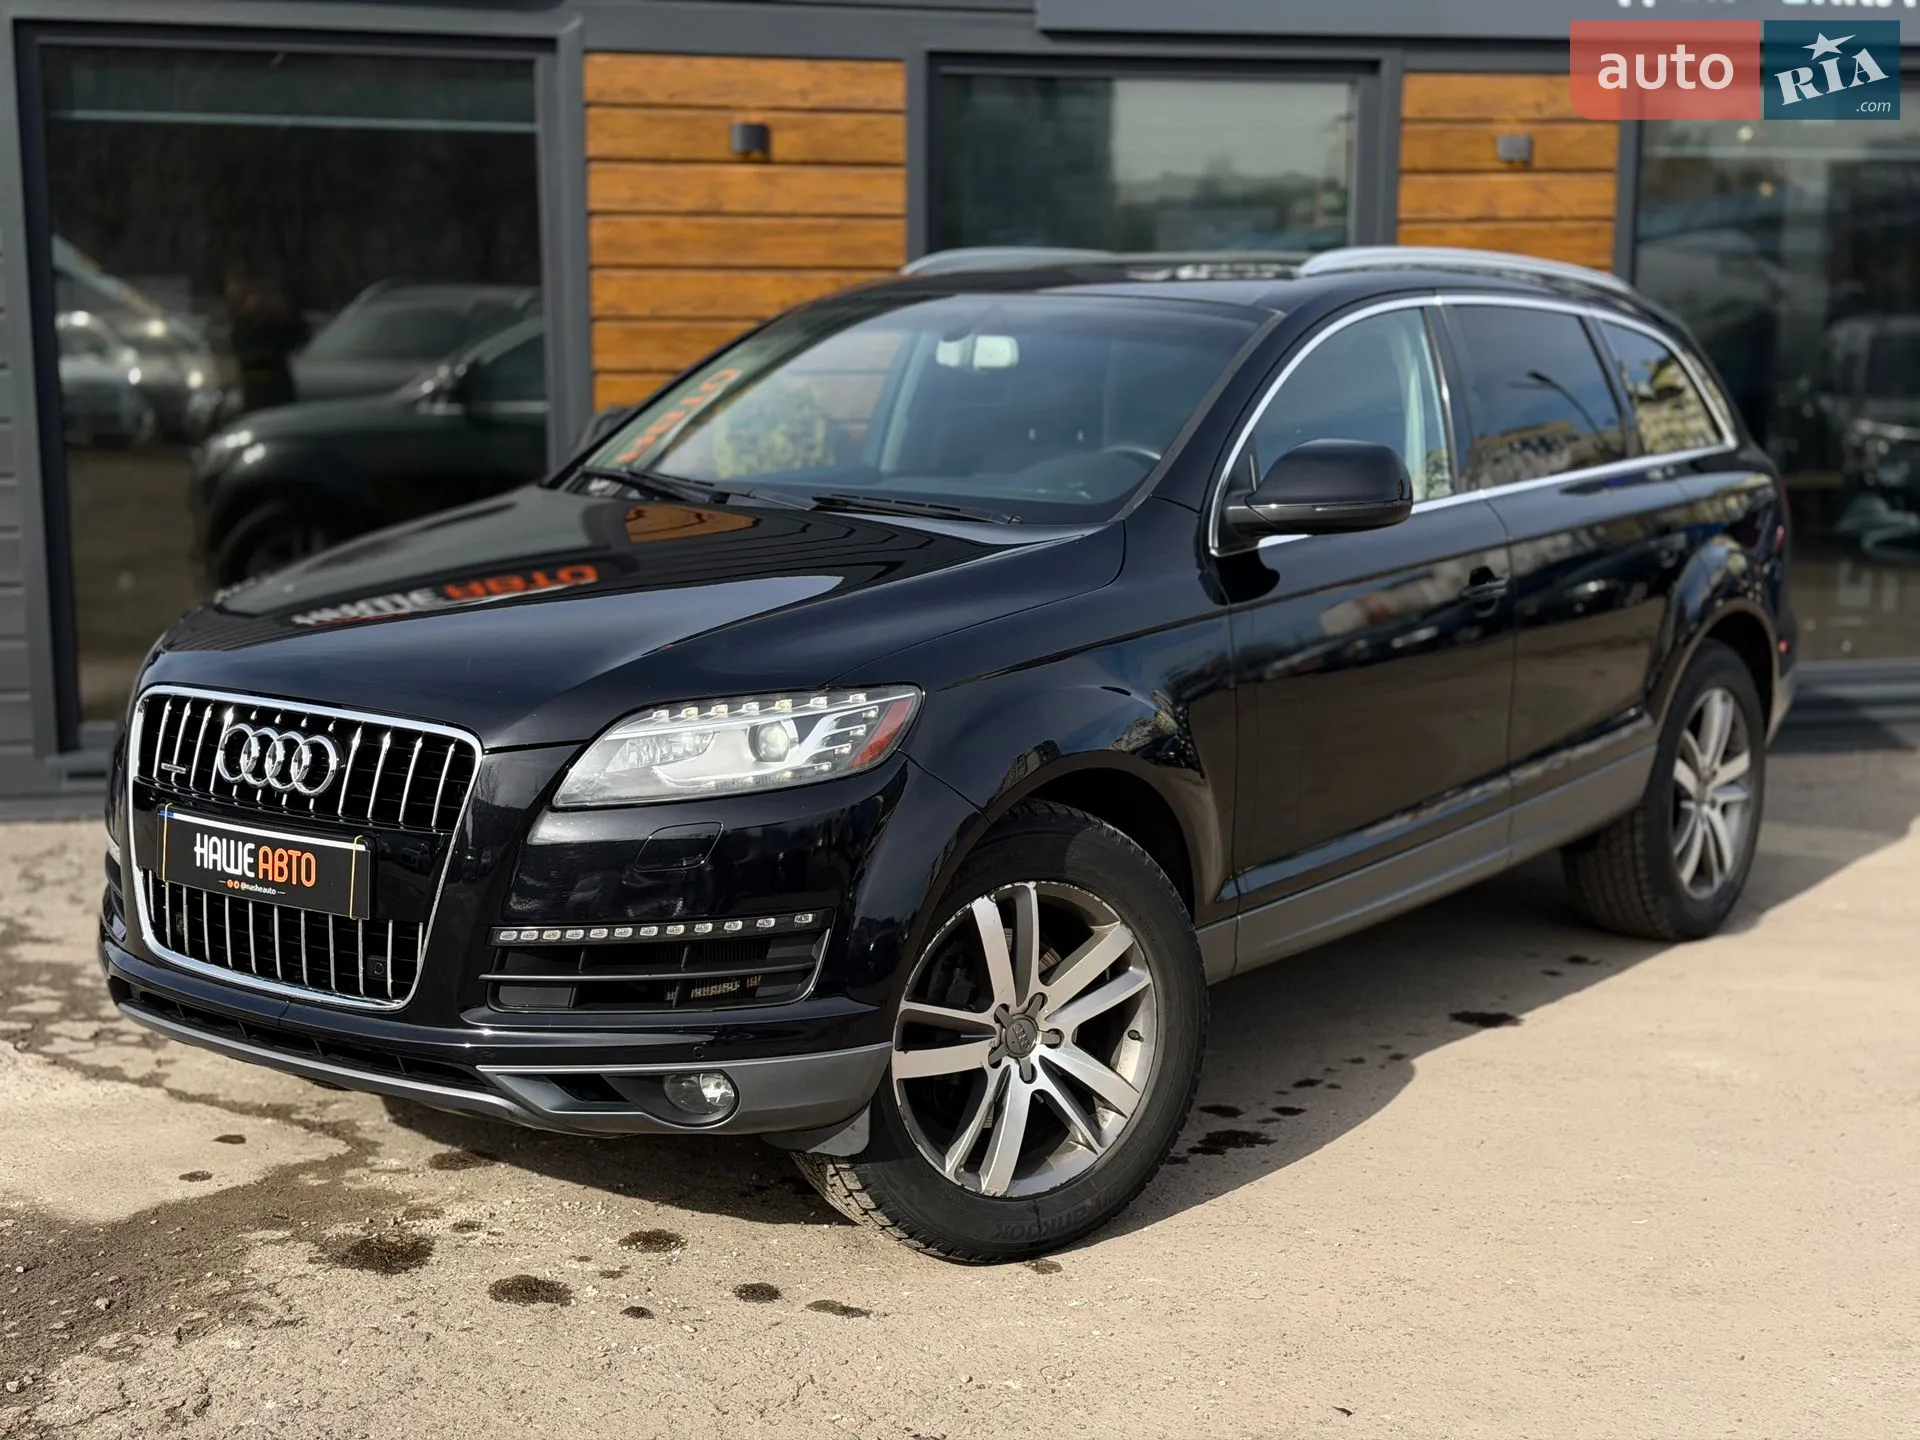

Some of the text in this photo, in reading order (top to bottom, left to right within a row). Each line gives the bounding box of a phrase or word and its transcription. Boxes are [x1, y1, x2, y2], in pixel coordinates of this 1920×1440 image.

[193, 832, 316, 888] НАШЕ АВТО
[240, 881, 277, 896] @nasheauto
